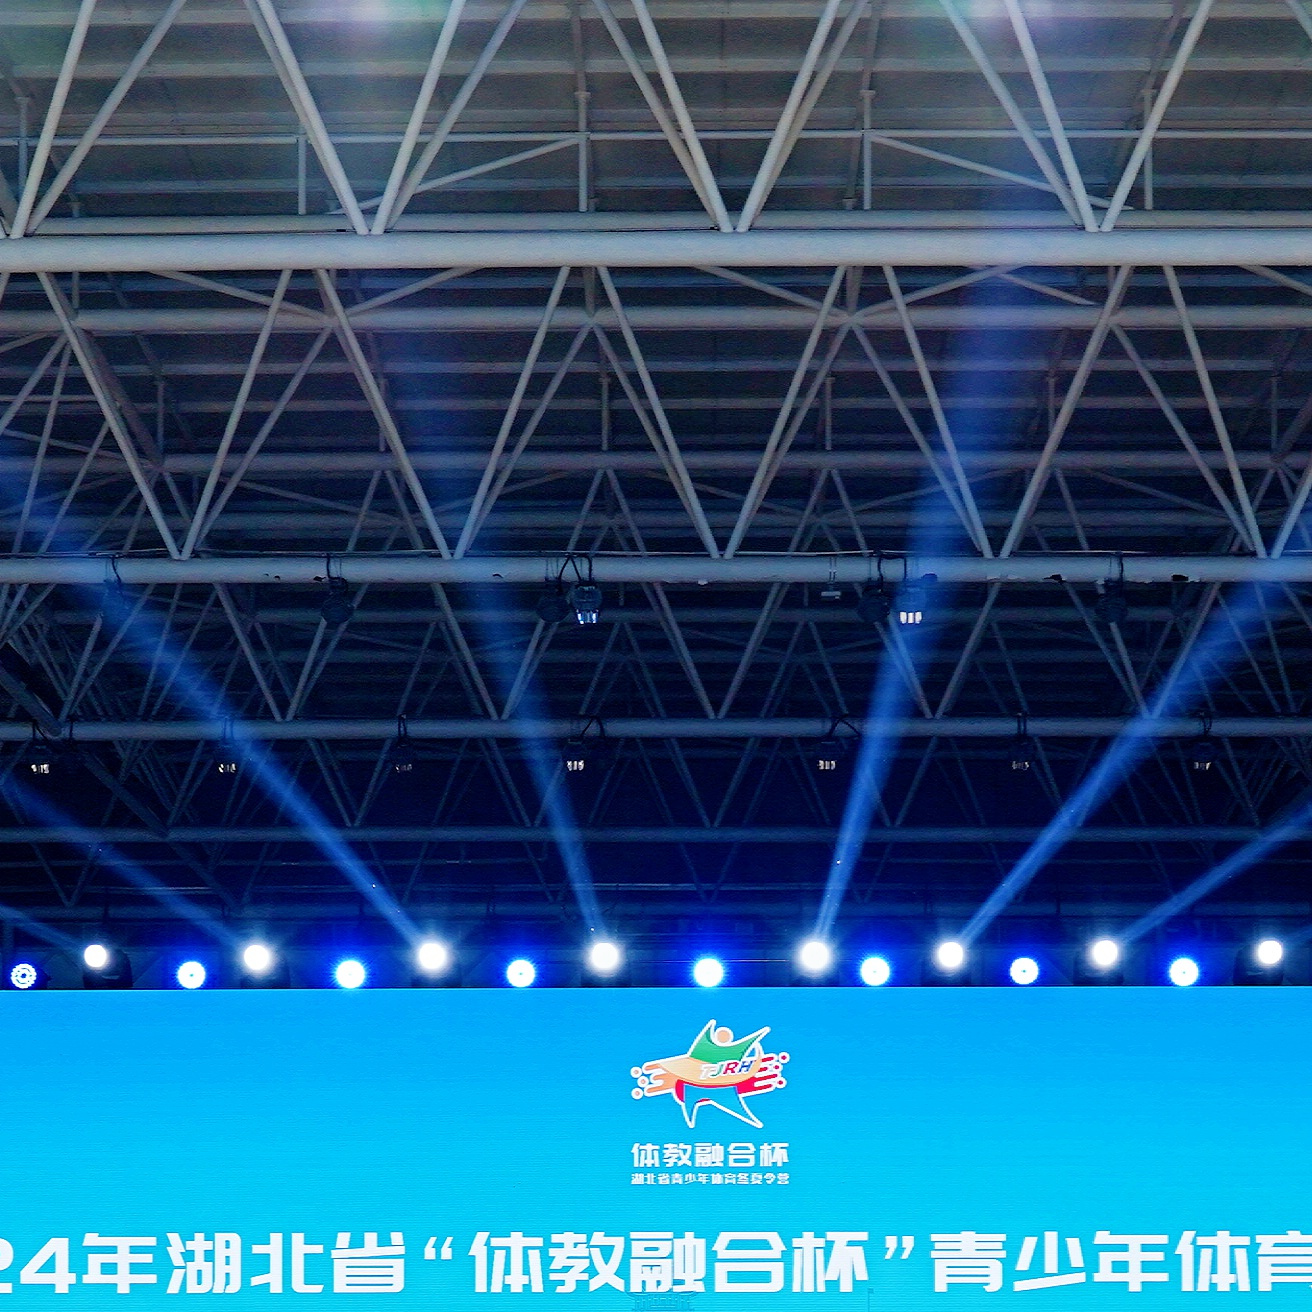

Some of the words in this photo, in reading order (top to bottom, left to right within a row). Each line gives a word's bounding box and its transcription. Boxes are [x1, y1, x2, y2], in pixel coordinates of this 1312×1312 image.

[631, 1143, 790, 1168] 体教融合杯
